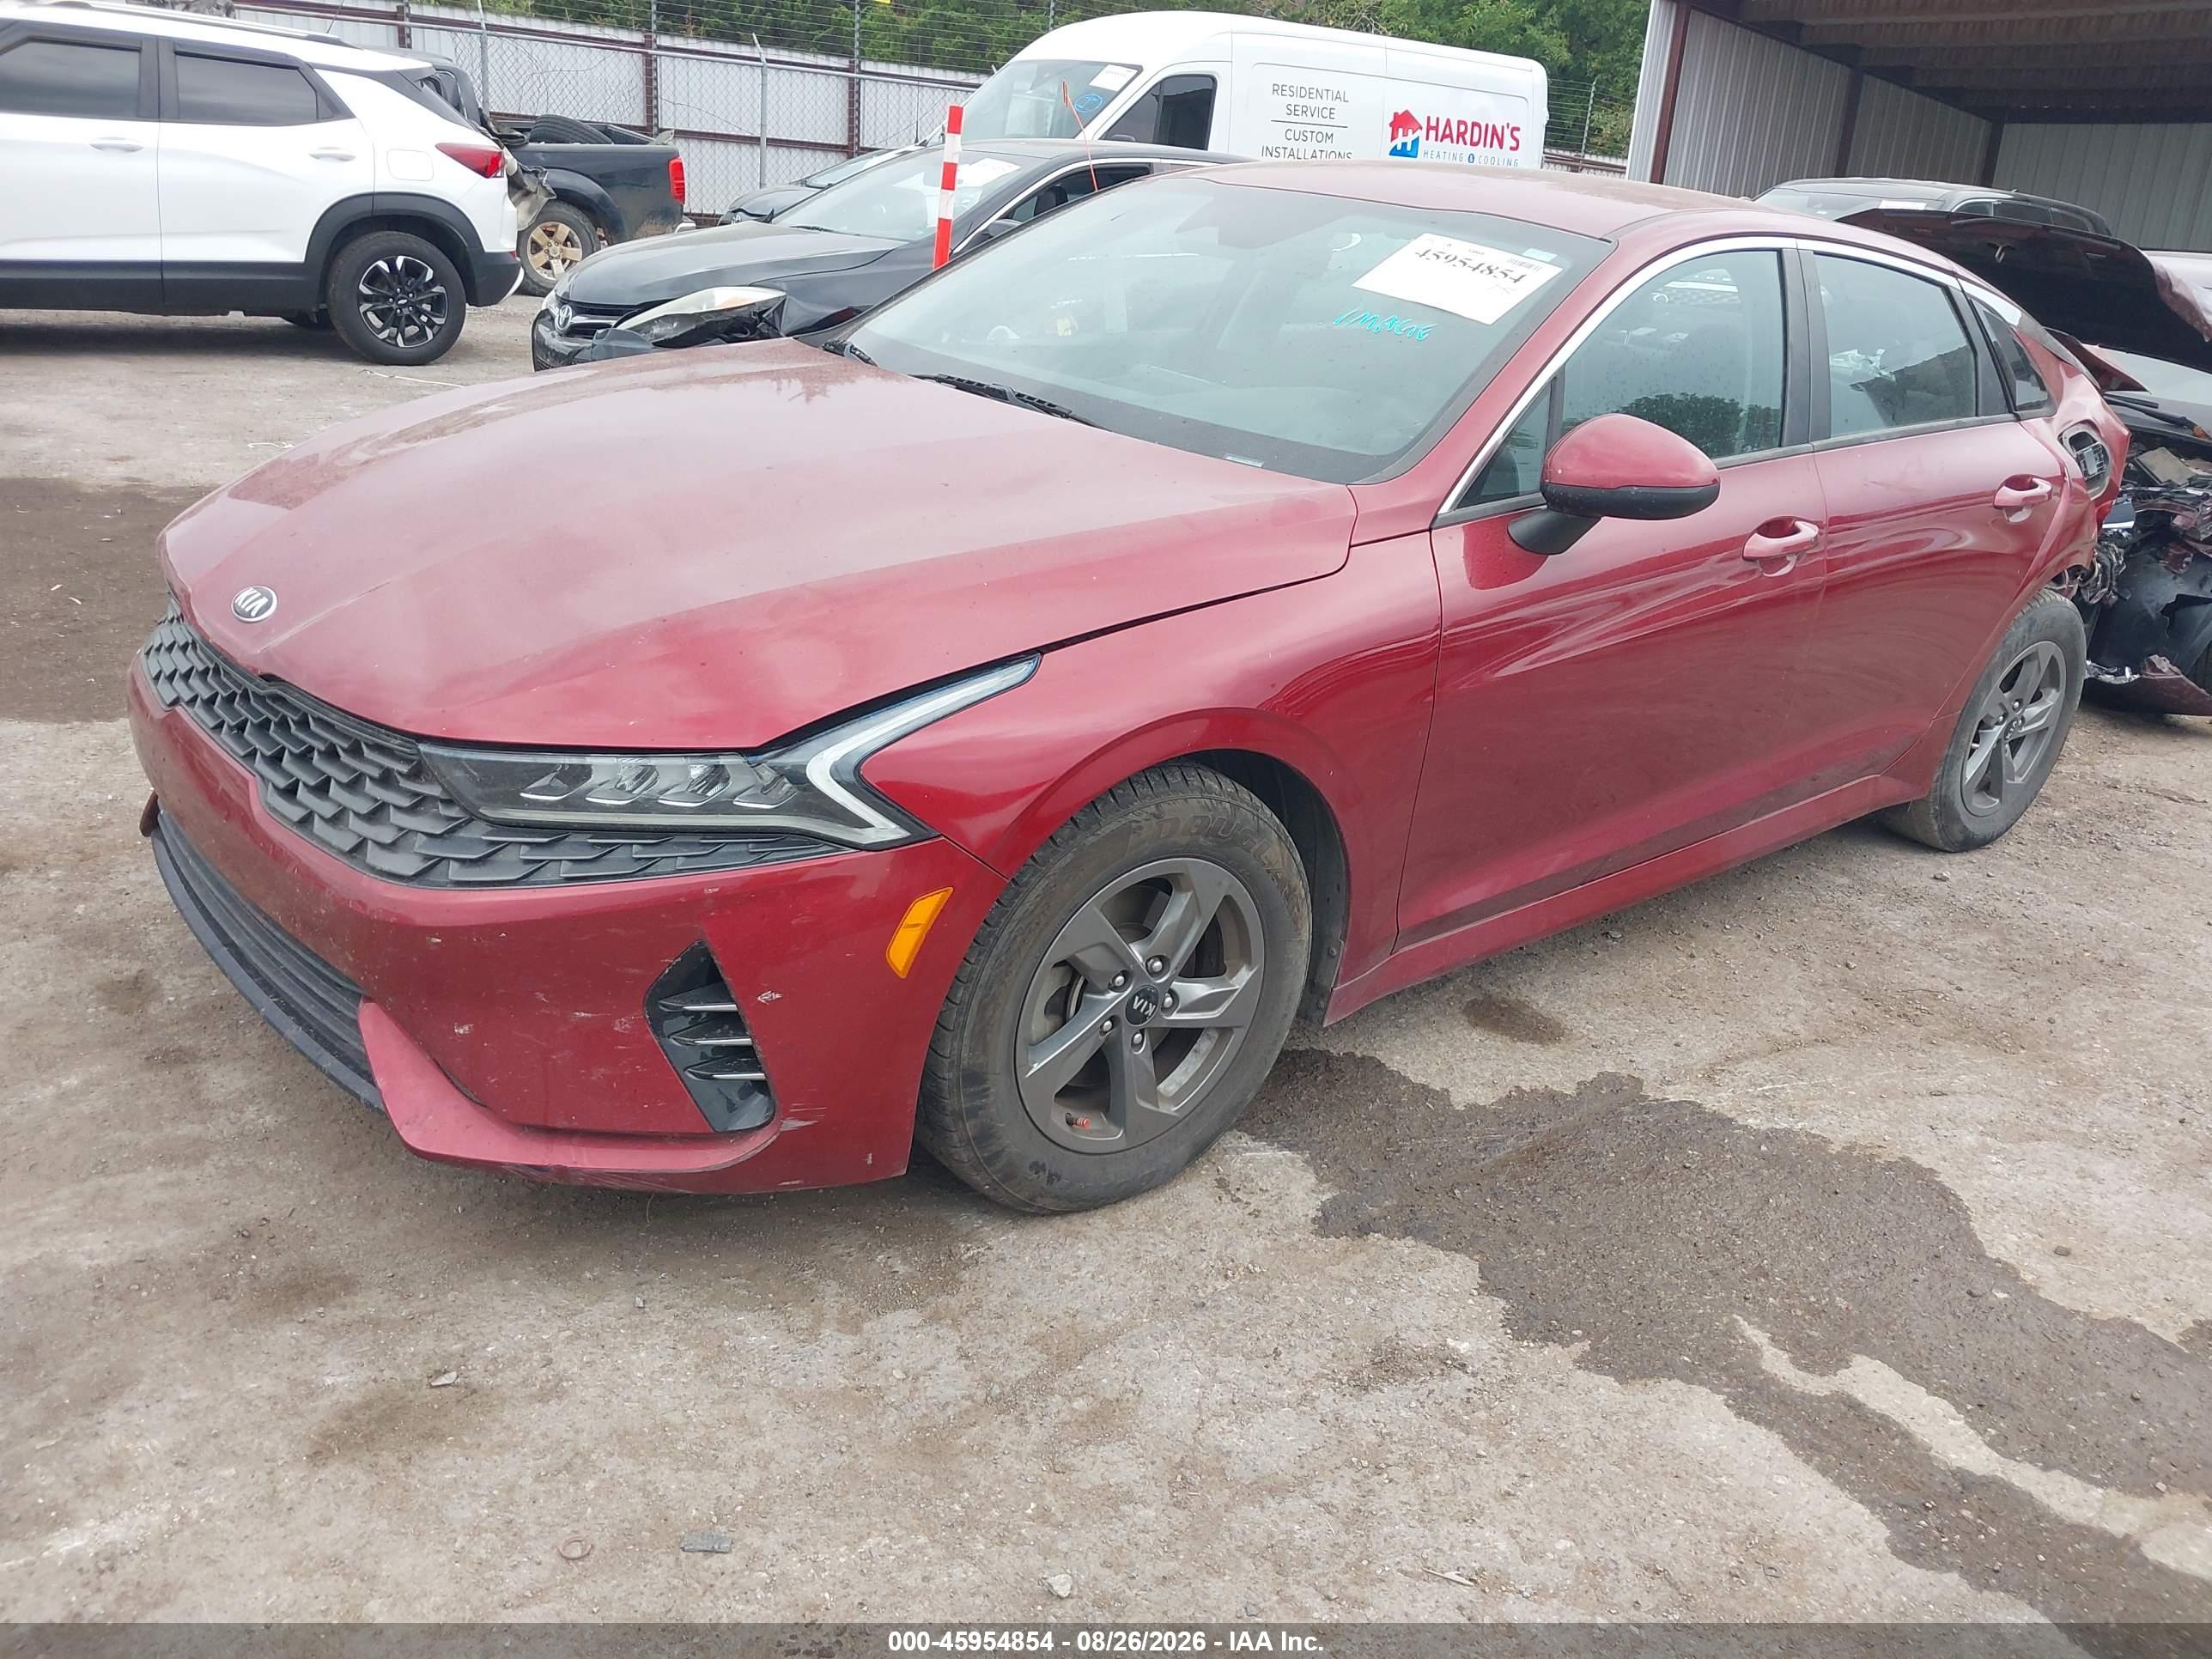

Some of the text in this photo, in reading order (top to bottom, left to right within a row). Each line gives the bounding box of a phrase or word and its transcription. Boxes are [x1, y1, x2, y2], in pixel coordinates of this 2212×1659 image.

[1272, 82, 1349, 103] RESIDENTIAL
[1285, 103, 1335, 120] SERVICE
[1285, 128, 1334, 144] CUSTOM
[1425, 115, 1520, 151] HARDIN'S
[1261, 144, 1352, 161] INSTALLATIONS
[1423, 149, 1464, 163] HEATING
[1478, 155, 1519, 167] COOLING
[1414, 247, 1527, 283] 45954854
[234, 586, 270, 618] KIA
[1133, 995, 1157, 1020] KIA
